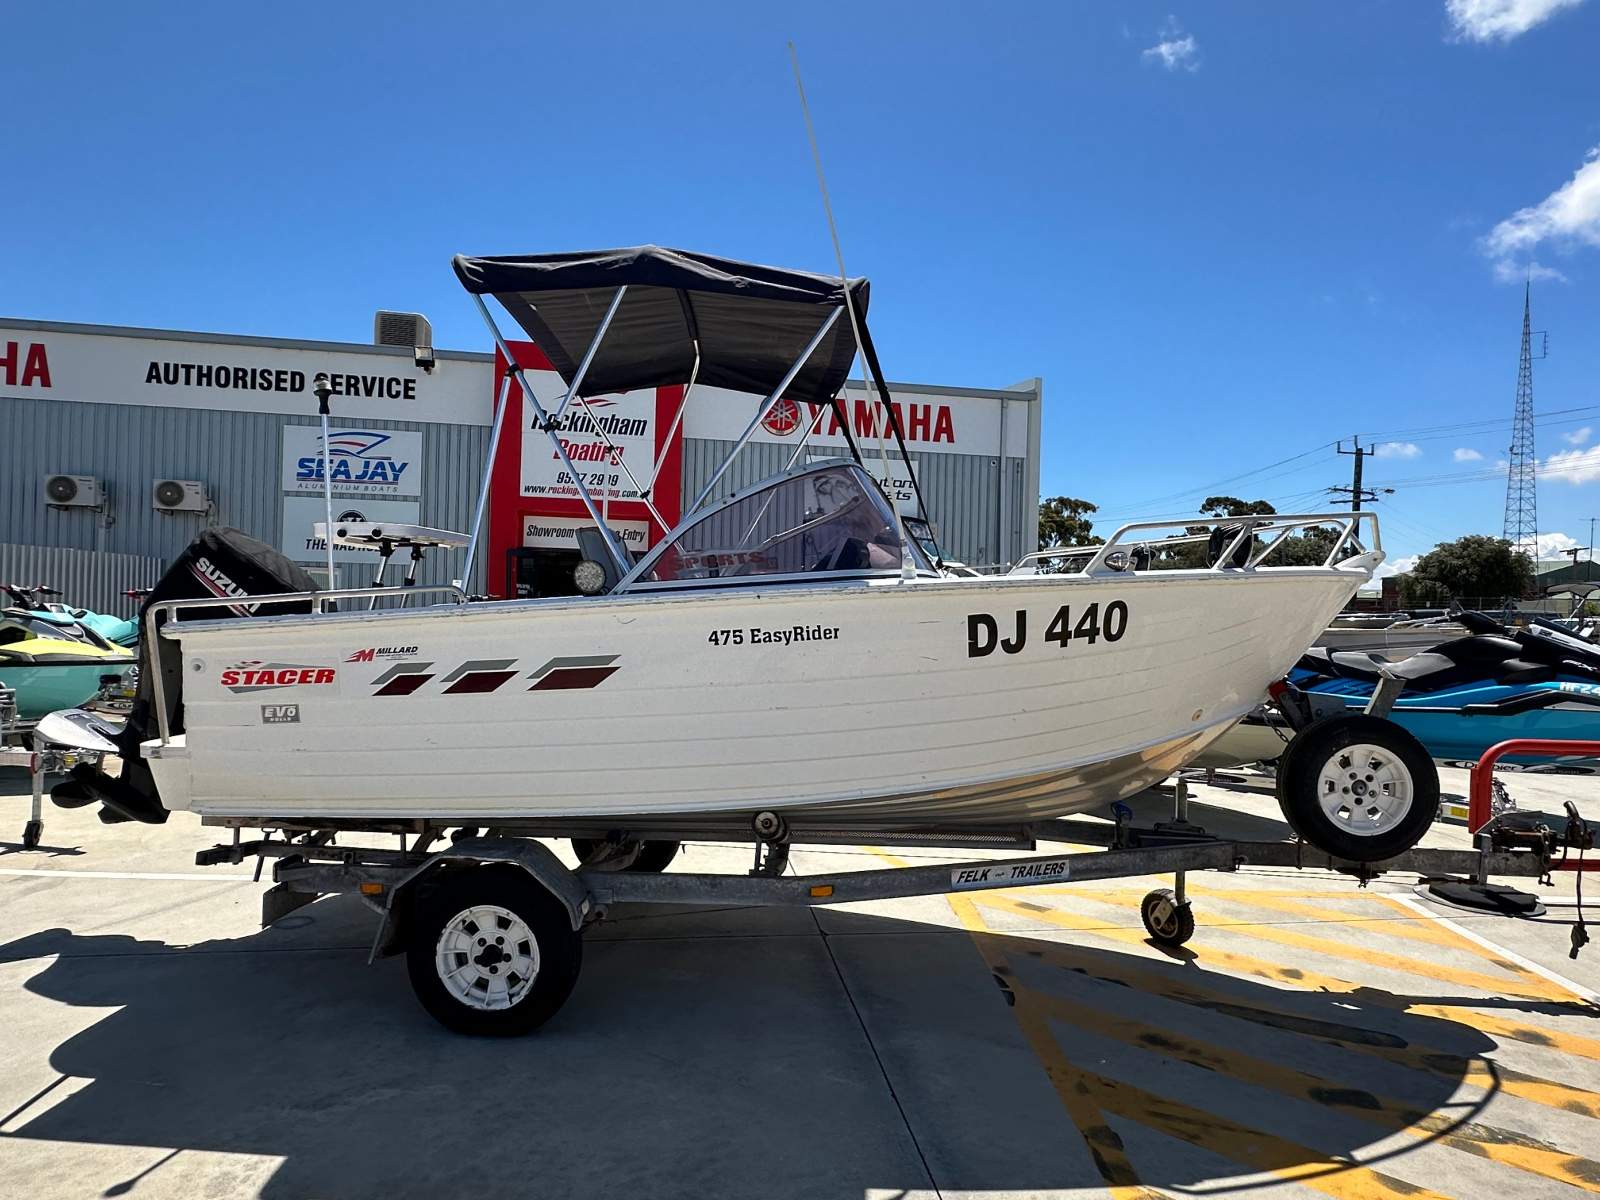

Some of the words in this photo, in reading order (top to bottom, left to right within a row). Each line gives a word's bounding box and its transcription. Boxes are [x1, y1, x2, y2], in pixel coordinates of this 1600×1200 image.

[145, 361, 304, 393] AUTHORISED
[808, 399, 955, 443] YAMAHA
[296, 457, 352, 480] SEA
[355, 460, 409, 481] JAY
[297, 482, 360, 491] ALUMNIUM
[363, 484, 399, 493] BOATS
[305, 538, 328, 551] THE
[526, 524, 576, 539] Showroom
[623, 528, 646, 543] Entry
[708, 629, 744, 646] 475
[750, 624, 840, 646] EasyRider
[967, 609, 1028, 659] DJ
[1043, 599, 1129, 649] 440
[376, 646, 418, 655] MILLARD
[220, 669, 336, 686] STACER
[957, 869, 992, 884] FELK
[1010, 861, 1066, 879] TRAILERS
